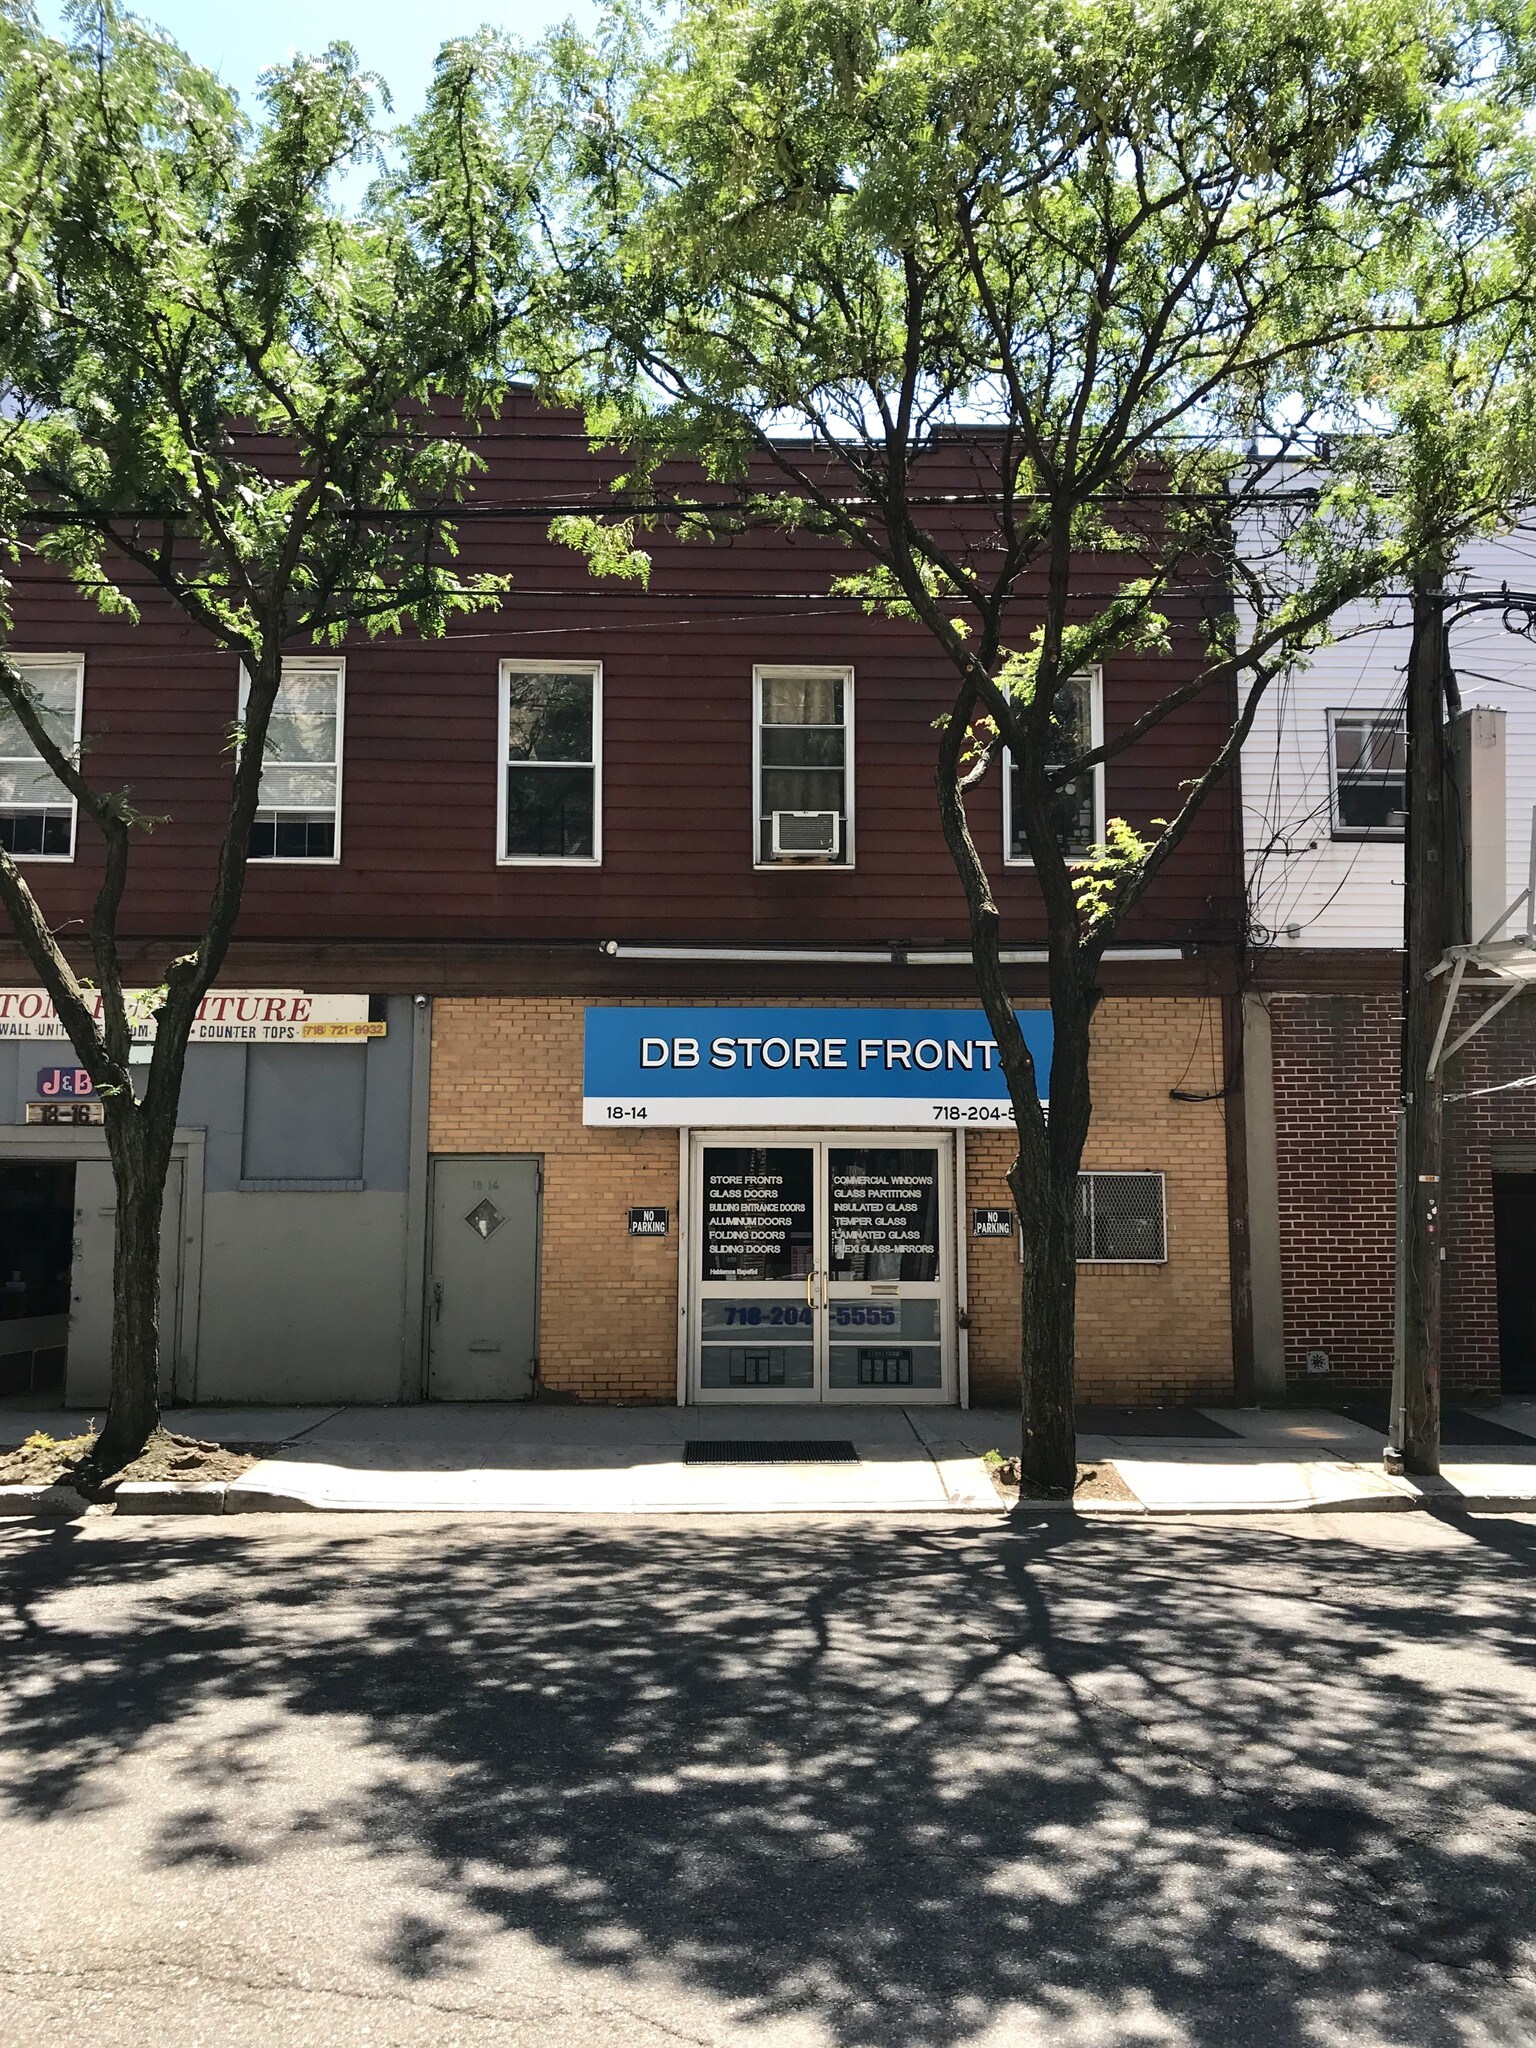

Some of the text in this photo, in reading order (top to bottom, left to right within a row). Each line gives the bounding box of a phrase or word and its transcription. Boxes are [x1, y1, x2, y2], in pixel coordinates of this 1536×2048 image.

[0, 1023, 295, 1039] WALL UNIT COUNTER TOPS
[330, 1024, 384, 1036] 721-8932
[639, 1037, 1003, 1071] DB STORE FRONT
[42, 1069, 94, 1095] J&B
[40, 1104, 91, 1124] 18-16
[606, 1106, 648, 1120] 18-14
[709, 1176, 783, 1185] STORE FRONTS
[833, 1176, 933, 1185] COMMERCIAL WINDOWS
[709, 1189, 779, 1199] GLASS DOORS
[834, 1189, 922, 1199] GLASS PARTITIONS
[709, 1203, 806, 1212] BUILDING ENTRANCE DOORS
[833, 1203, 918, 1212] INSULATED GLASS
[643, 1210, 655, 1221] NO
[987, 1211, 999, 1222] NO
[632, 1221, 666, 1232] PARKING
[709, 1217, 792, 1226] ALUMINUM DOORS
[834, 1217, 907, 1227] TEMPER GLASS
[976, 1222, 1010, 1233] PARKING
[709, 1231, 786, 1240] FOLDING DOORS
[834, 1231, 920, 1240] LAMINATED GLASS
[709, 1245, 781, 1254] SLIDING DOORS
[860, 1244, 935, 1254] GLASS-MIRRORS
